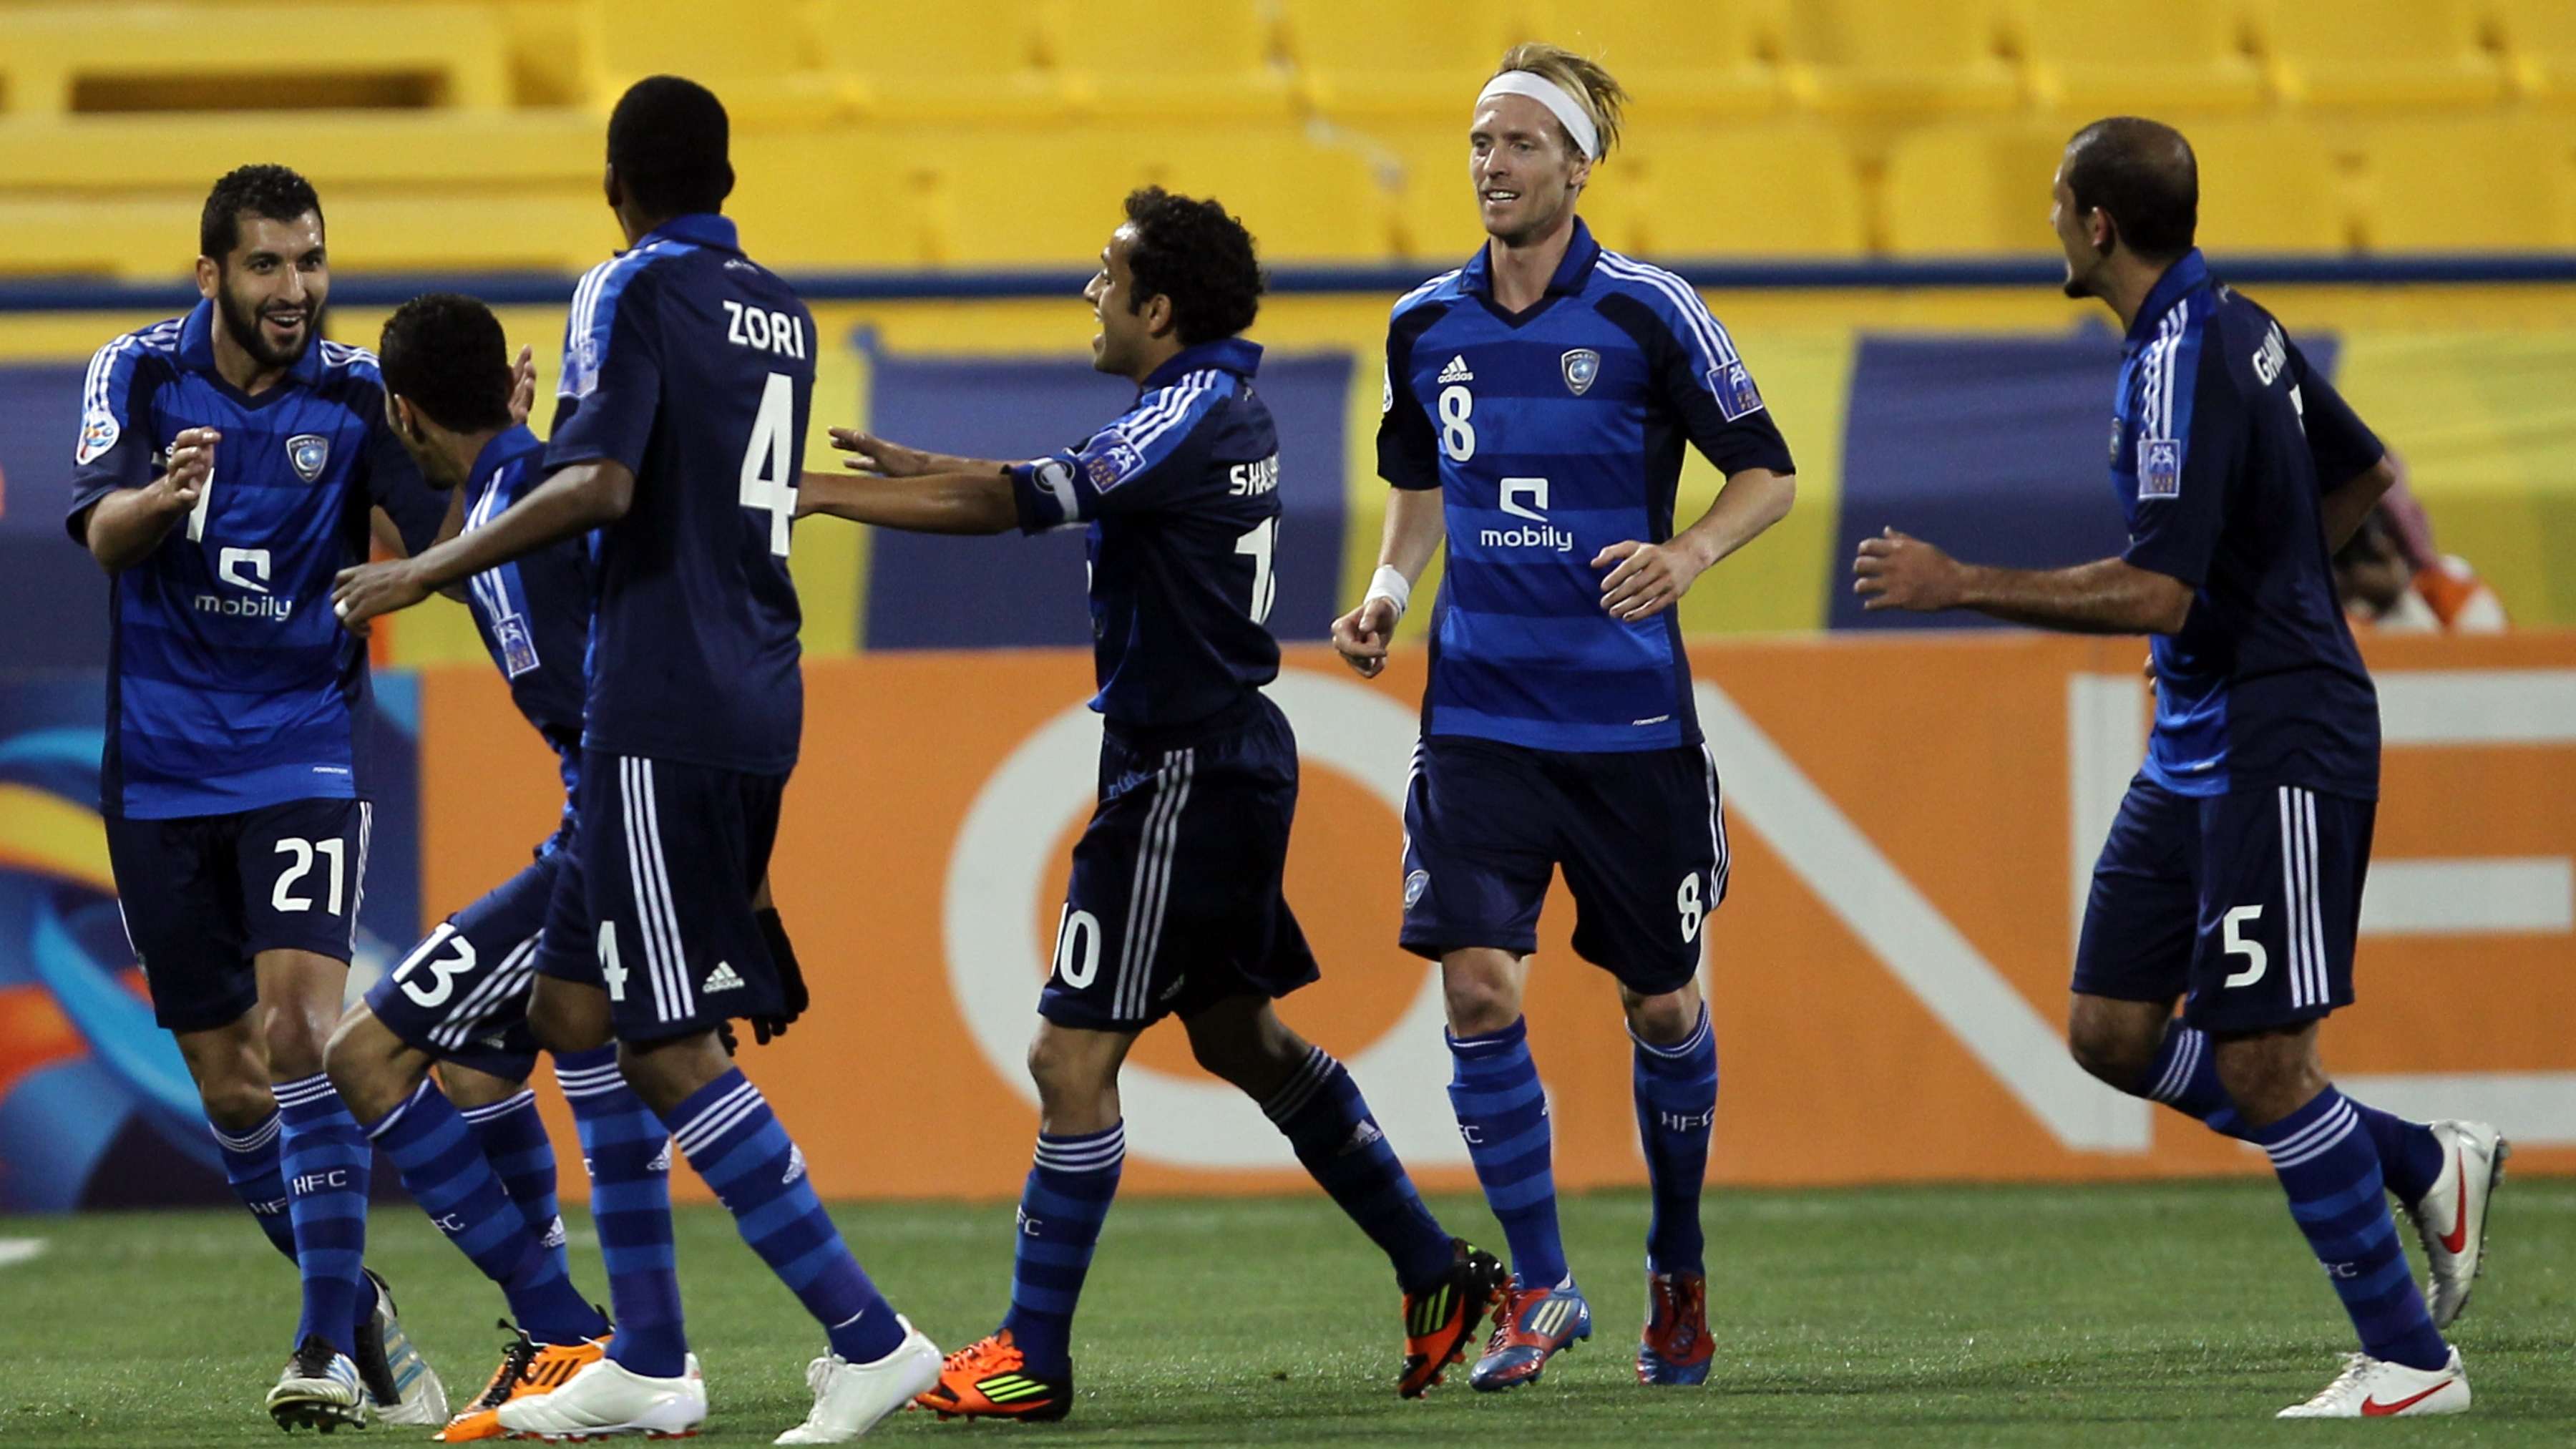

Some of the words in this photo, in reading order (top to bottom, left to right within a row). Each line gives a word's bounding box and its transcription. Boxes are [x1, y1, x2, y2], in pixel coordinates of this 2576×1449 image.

[723, 299, 805, 359] ZORI
[1438, 371, 1474, 384] adidas
[1438, 385, 1475, 462] 8
[739, 371, 799, 557] 4
[1480, 525, 1573, 552] mobily
[195, 594, 292, 621] mobily
[272, 837, 343, 916] 21
[1677, 872, 1703, 944] 8
[392, 922, 477, 1008] 13
[597, 920, 628, 1002] 4
[2223, 904, 2268, 988] 5
[1662, 1106, 1714, 1132] HFC
[250, 1197, 286, 1214] HF
[293, 1169, 347, 1196] HFC
[1016, 1204, 1043, 1236] FC
